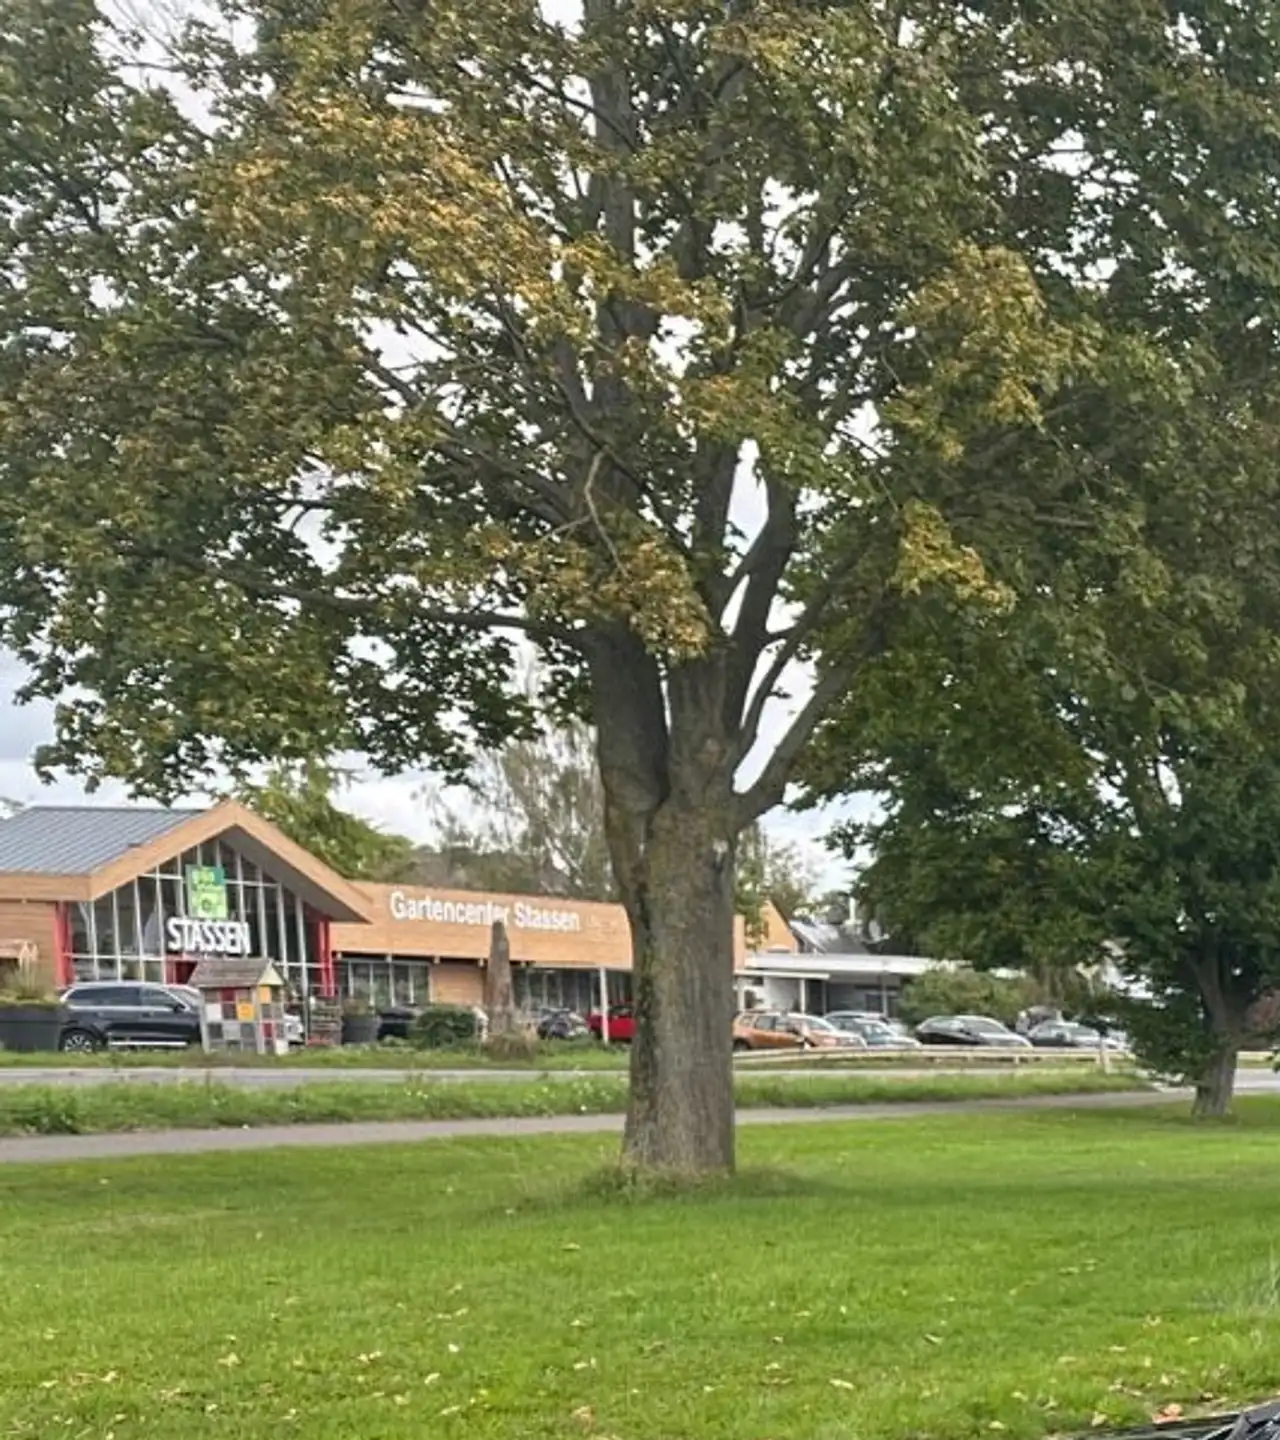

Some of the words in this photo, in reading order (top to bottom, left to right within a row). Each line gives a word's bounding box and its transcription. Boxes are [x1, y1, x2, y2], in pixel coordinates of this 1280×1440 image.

[389, 890, 510, 926] Gartencenter
[513, 902, 580, 932] Stassen
[166, 916, 252, 955] STASSEN
